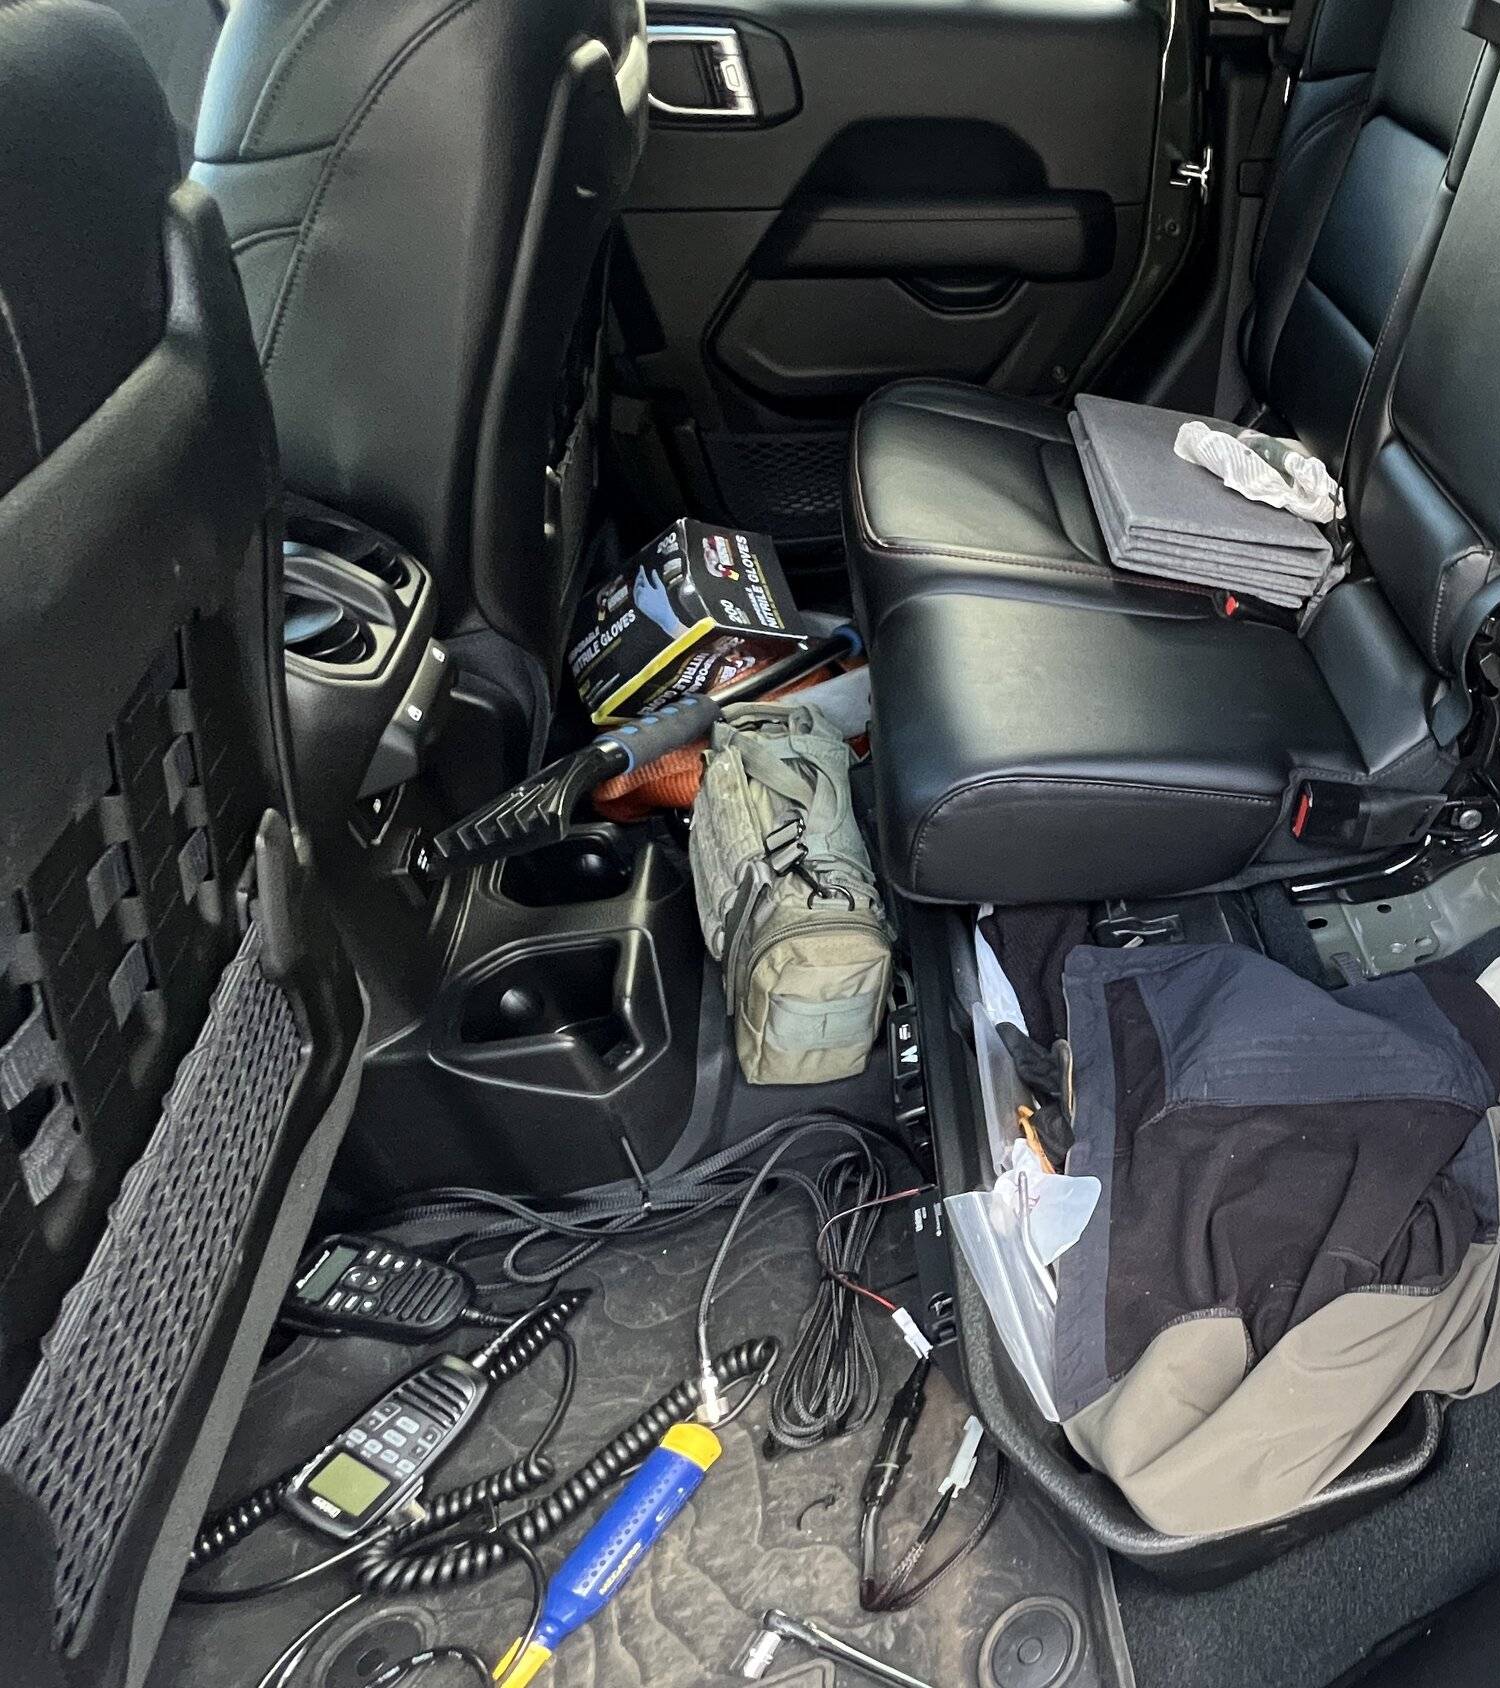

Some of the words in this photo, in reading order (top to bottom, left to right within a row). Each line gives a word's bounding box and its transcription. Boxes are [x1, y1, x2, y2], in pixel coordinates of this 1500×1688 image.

[735, 534, 761, 583] GLOVES
[720, 599, 744, 624] 200
[751, 584, 780, 629] NITRILE
[571, 640, 601, 679] NITRILE
[599, 608, 636, 646] GLOVES
